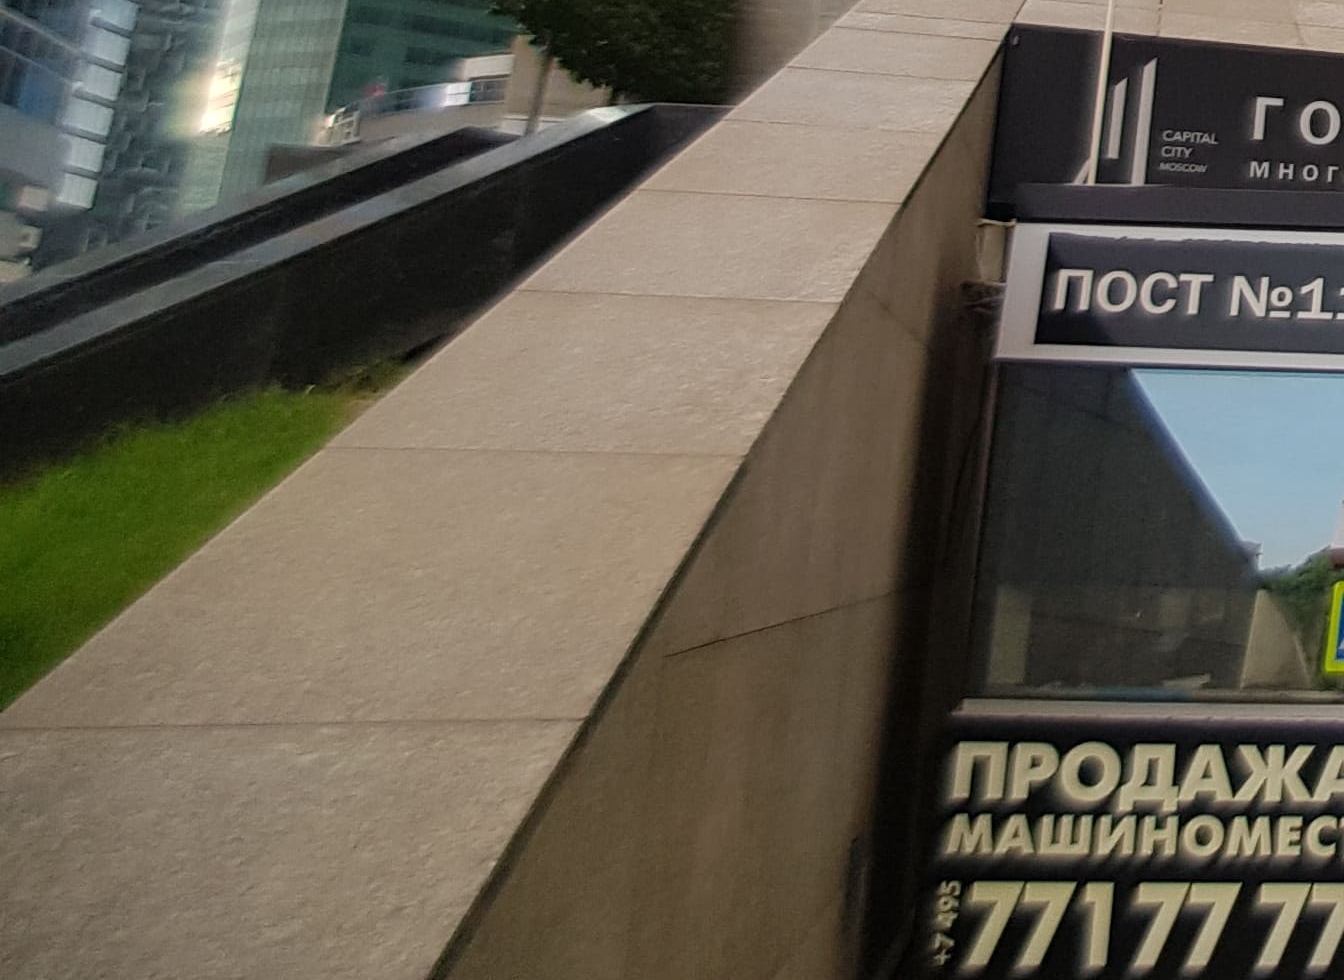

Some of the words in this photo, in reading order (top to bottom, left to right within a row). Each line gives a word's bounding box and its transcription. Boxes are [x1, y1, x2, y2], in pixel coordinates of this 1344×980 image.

[1162, 129, 1219, 145] CAPITAL
[1161, 146, 1193, 158] CITY
[1158, 162, 1207, 173] MOSCOW
[1053, 268, 1214, 316] ПОСТ
[1130, 882, 1241, 968] 77
